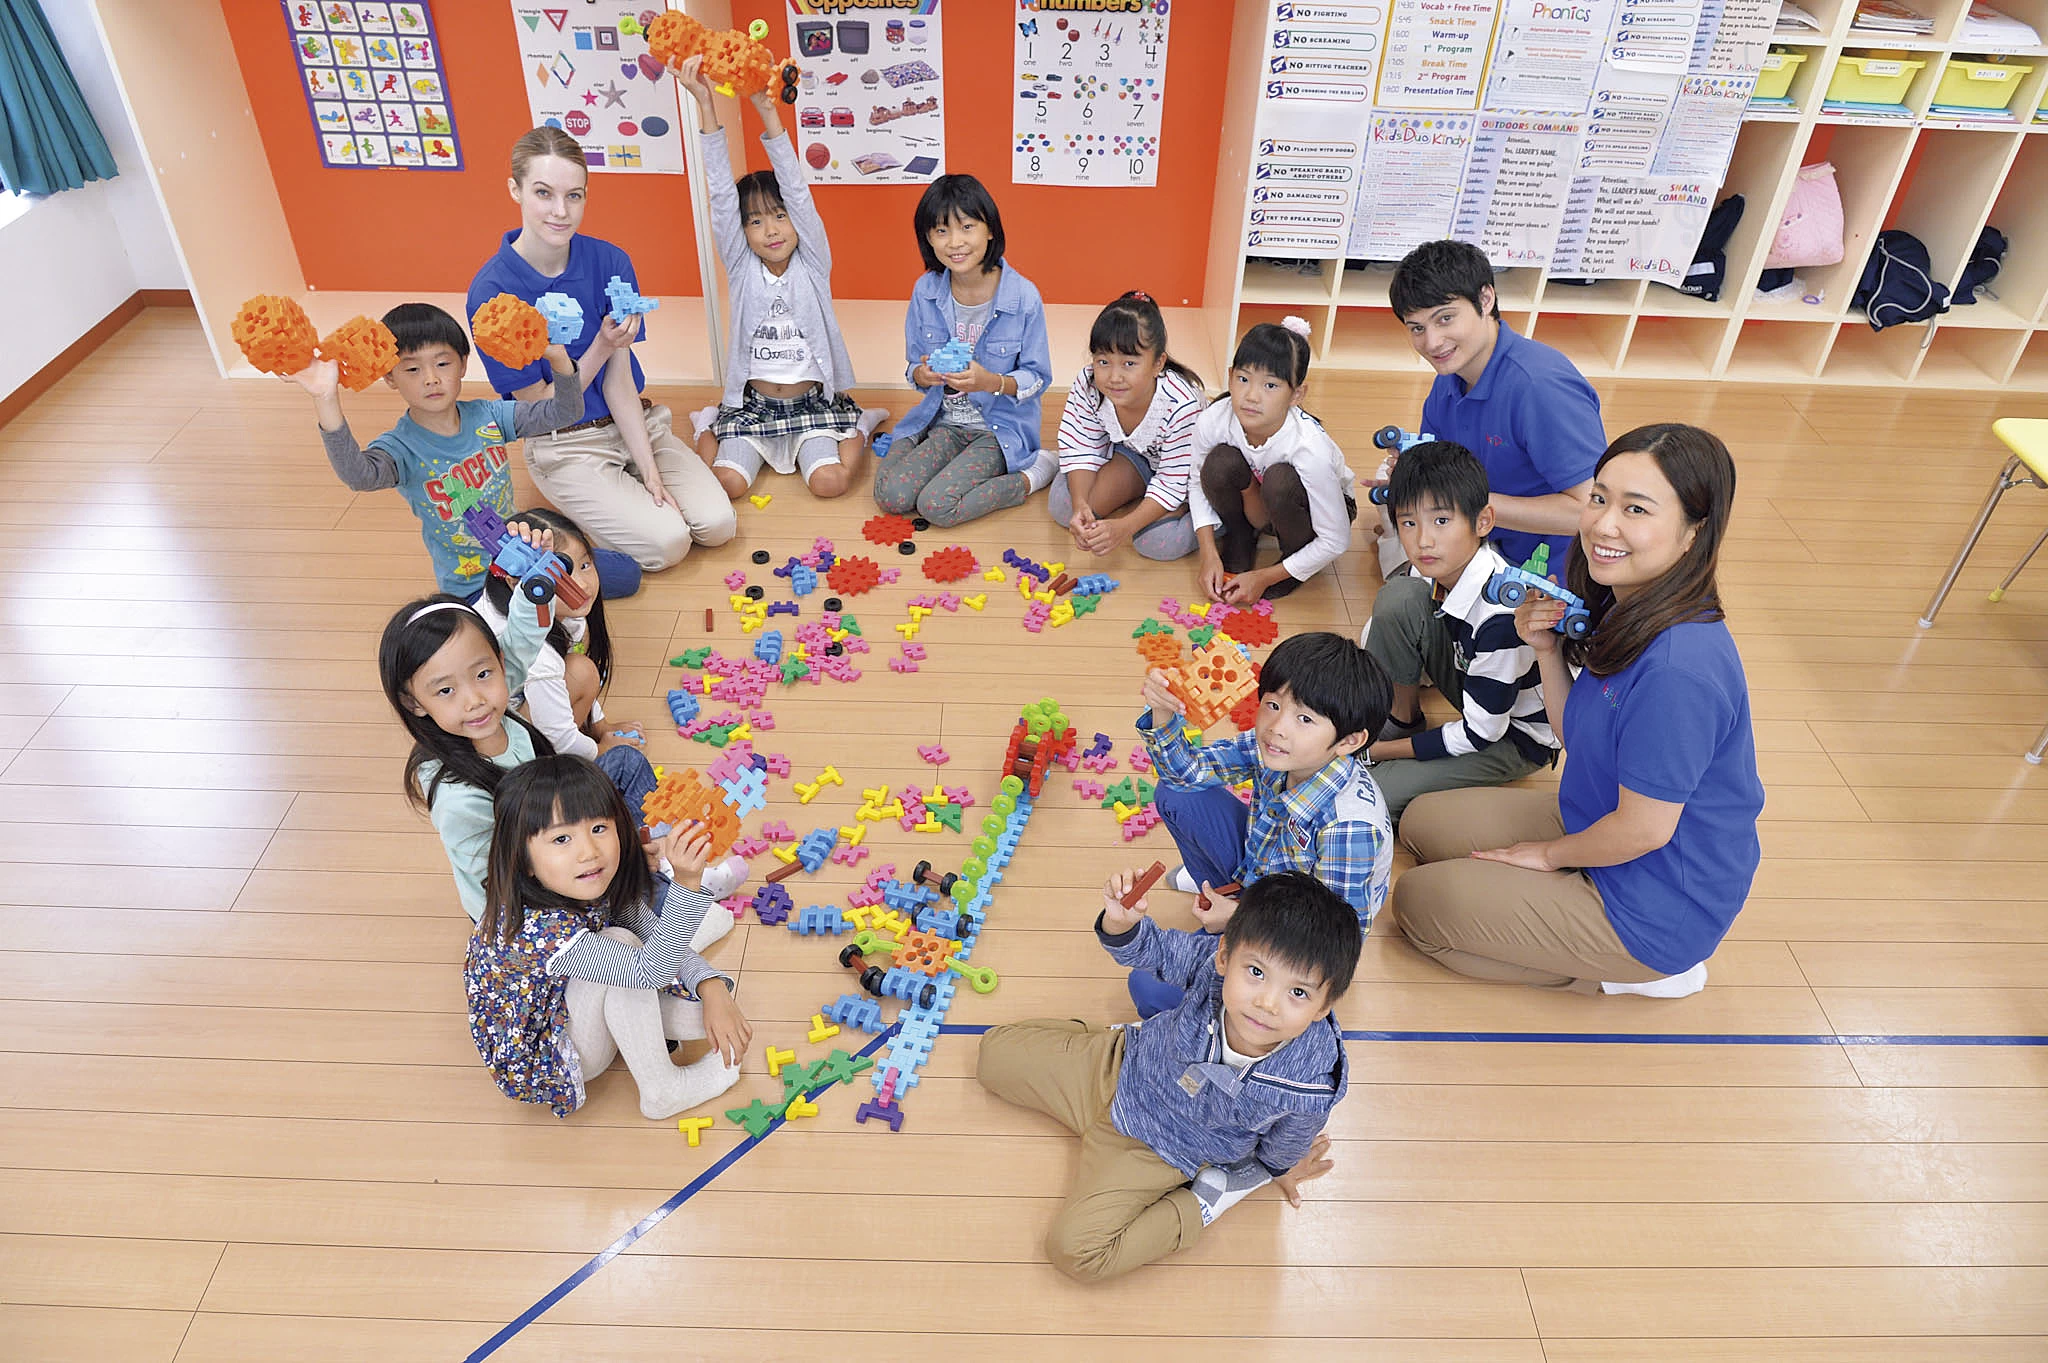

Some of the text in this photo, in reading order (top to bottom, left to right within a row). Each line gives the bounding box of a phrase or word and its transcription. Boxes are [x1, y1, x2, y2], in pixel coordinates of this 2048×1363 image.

[1420, 2, 1445, 10] Vocab
[1532, 2, 1591, 22] Phonics
[1429, 16, 1477, 26] Snack Time
[1432, 31, 1469, 40] Warm-up
[1061, 42, 1072, 60] 2
[1099, 43, 1110, 61] 3
[1145, 44, 1157, 62] 4
[1437, 45, 1472, 54] Program
[1095, 60, 1112, 68] three
[1421, 59, 1468, 68] Break Time
[1431, 73, 1466, 82] Program
[1404, 87, 1475, 96] Presentation Time
[1036, 100, 1047, 117] 5
[1082, 102, 1093, 118] 6
[1132, 104, 1144, 121] 7
[565, 117, 589, 129] STOP
[1035, 116, 1047, 125] five
[1481, 120, 1579, 132] OUTDOORS COMMAND
[1374, 127, 1467, 148] Kids Duo Kindy
[1030, 155, 1041, 172] 8
[1078, 157, 1089, 174] 9
[1129, 158, 1144, 175] 10
[1075, 172, 1090, 181] nine
[1611, 186, 1638, 195] LEADER'S
[1670, 183, 1701, 193] SNACK
[1658, 193, 1708, 205] COMMAND
[1629, 258, 1681, 276] Kids Duo
